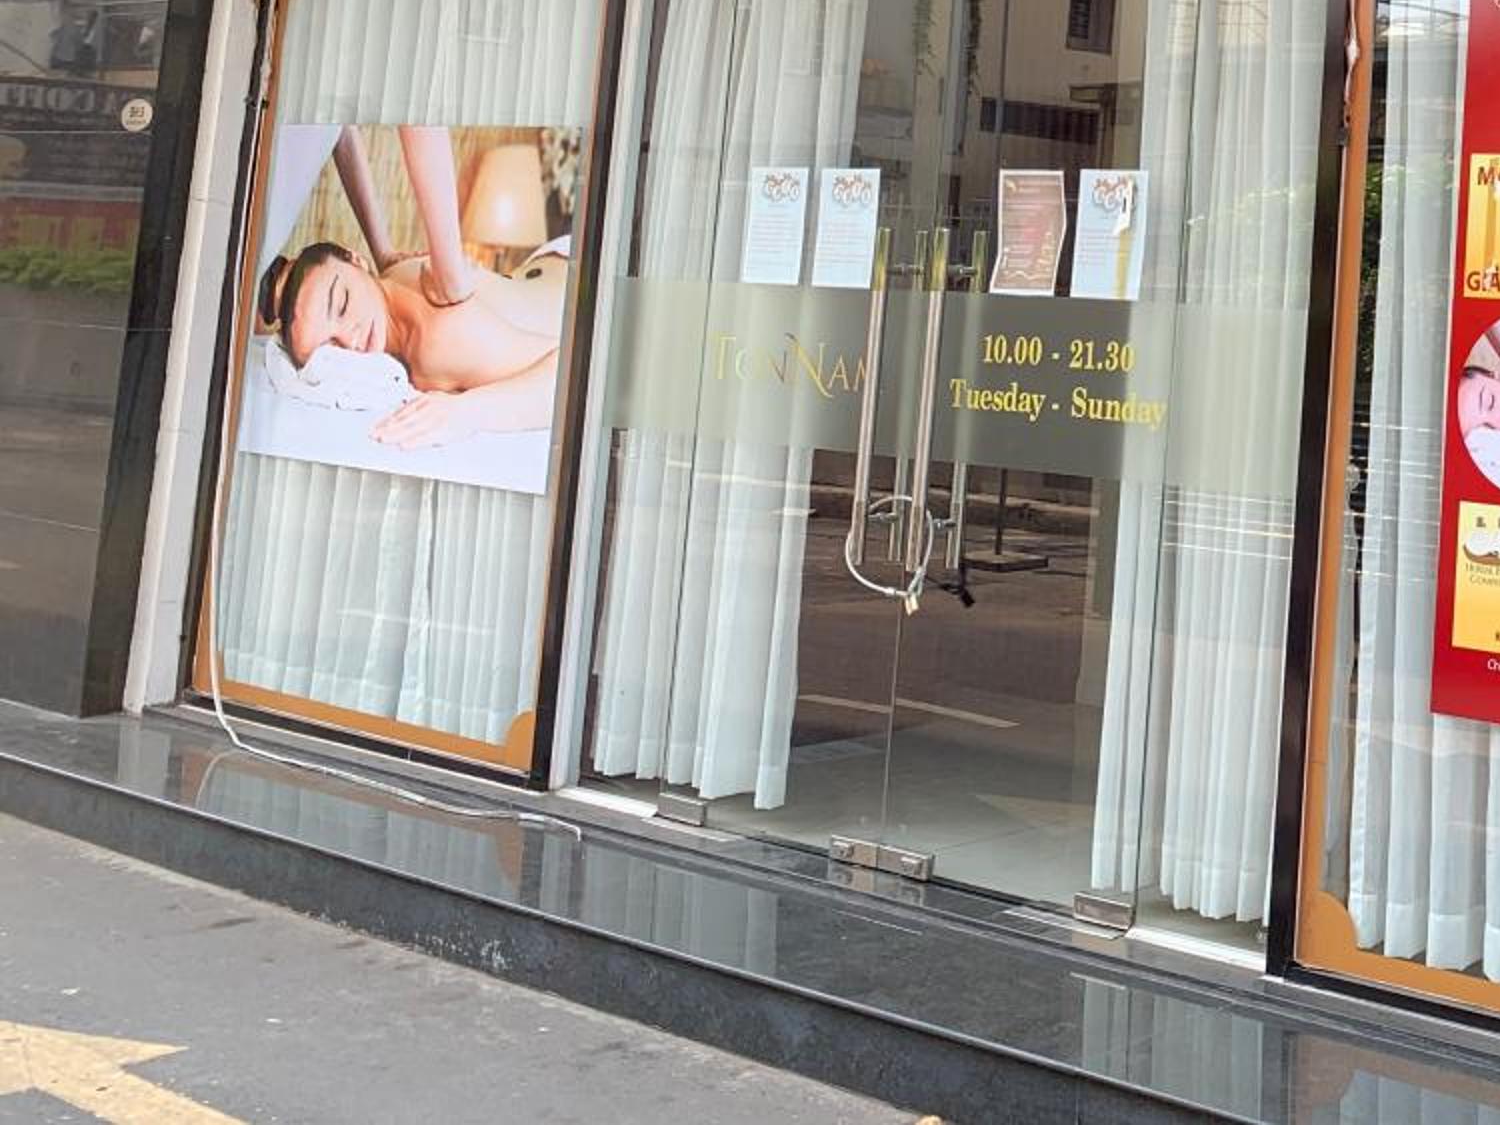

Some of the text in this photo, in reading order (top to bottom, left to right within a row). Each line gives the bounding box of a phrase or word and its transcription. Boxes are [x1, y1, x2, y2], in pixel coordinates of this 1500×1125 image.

[983, 334, 1043, 366] 10.00
[1069, 339, 1135, 372] 21.30
[951, 378, 1046, 422] Tuesday
[1071, 386, 1167, 431] Sunday
